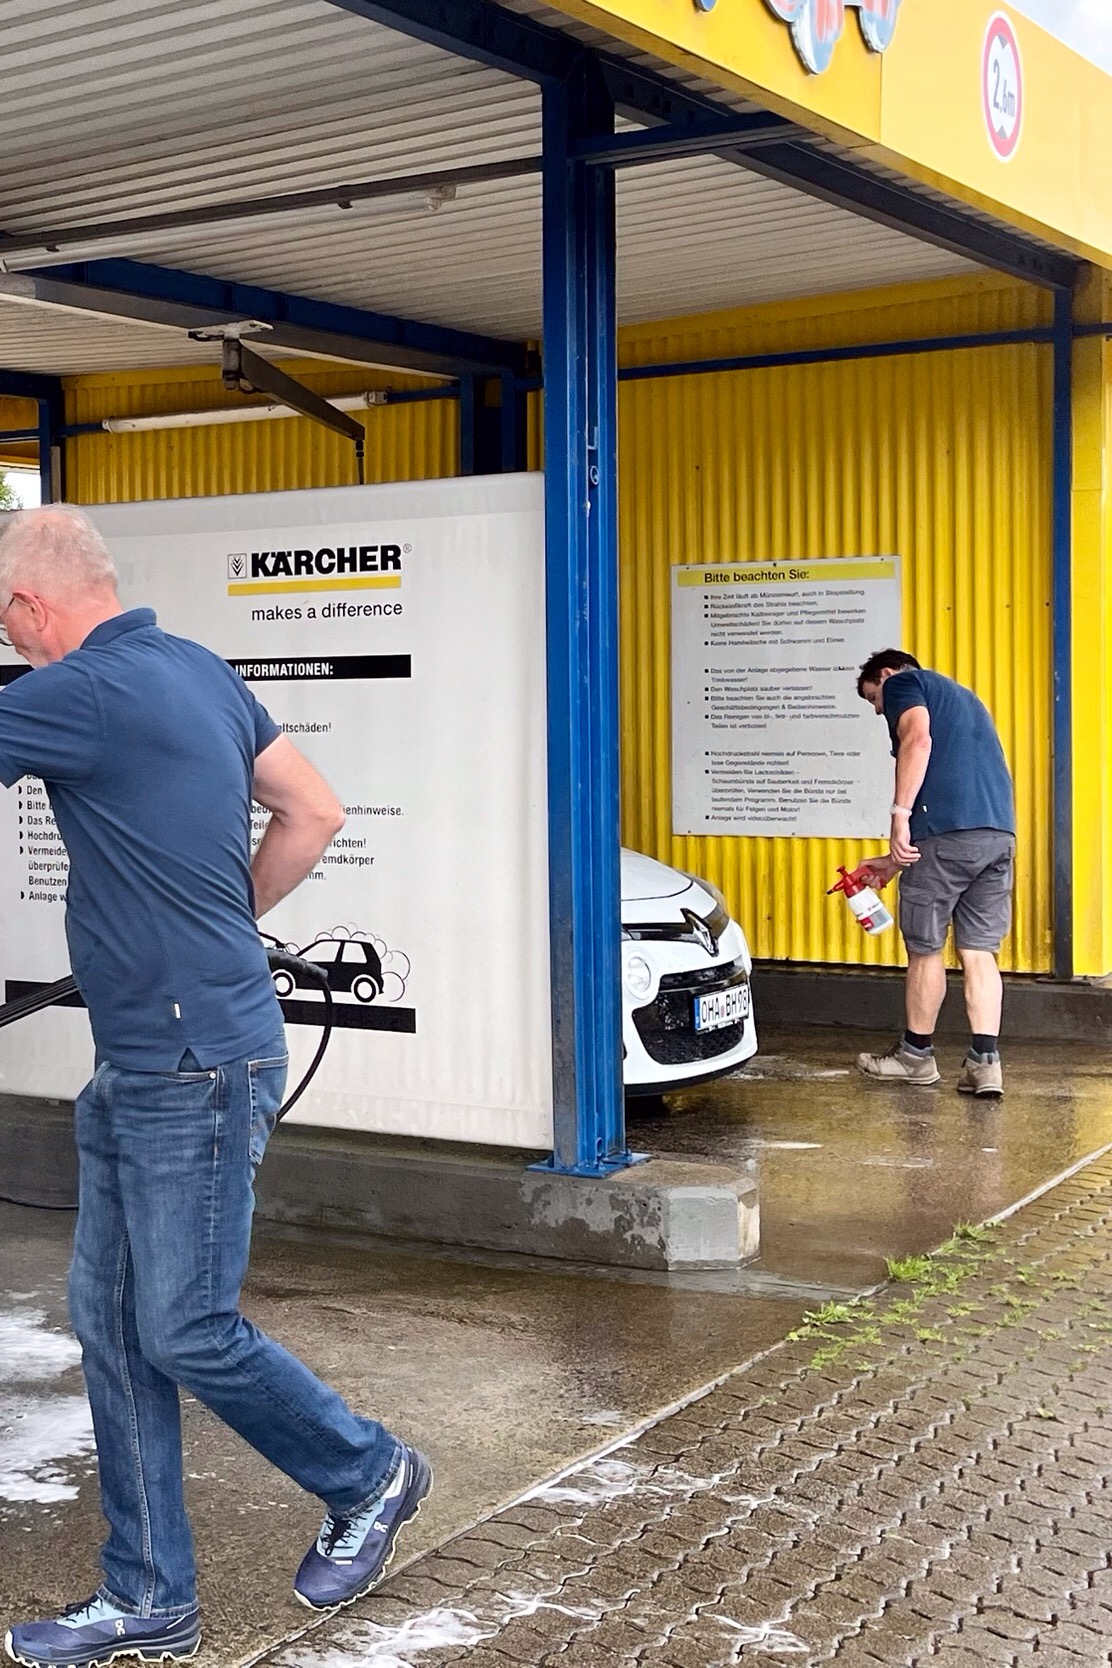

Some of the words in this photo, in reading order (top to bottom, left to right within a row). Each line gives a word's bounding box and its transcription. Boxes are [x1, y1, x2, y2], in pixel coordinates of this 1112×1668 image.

[251, 544, 402, 578] KÄRCHER
[704, 572, 730, 583] Bitte
[733, 570, 785, 582] beachten
[789, 569, 809, 580] Sie:
[251, 605, 302, 621] makes
[307, 607, 316, 619] a
[321, 603, 403, 618] difference
[26, 785, 43, 795] Den
[26, 801, 47, 810] Bitte
[27, 816, 43, 825] Das
[27, 846, 67, 855] Vermeide
[28, 861, 69, 872] überprüfe
[28, 876, 67, 886] Benutzen
[28, 891, 58, 903] Anlage
